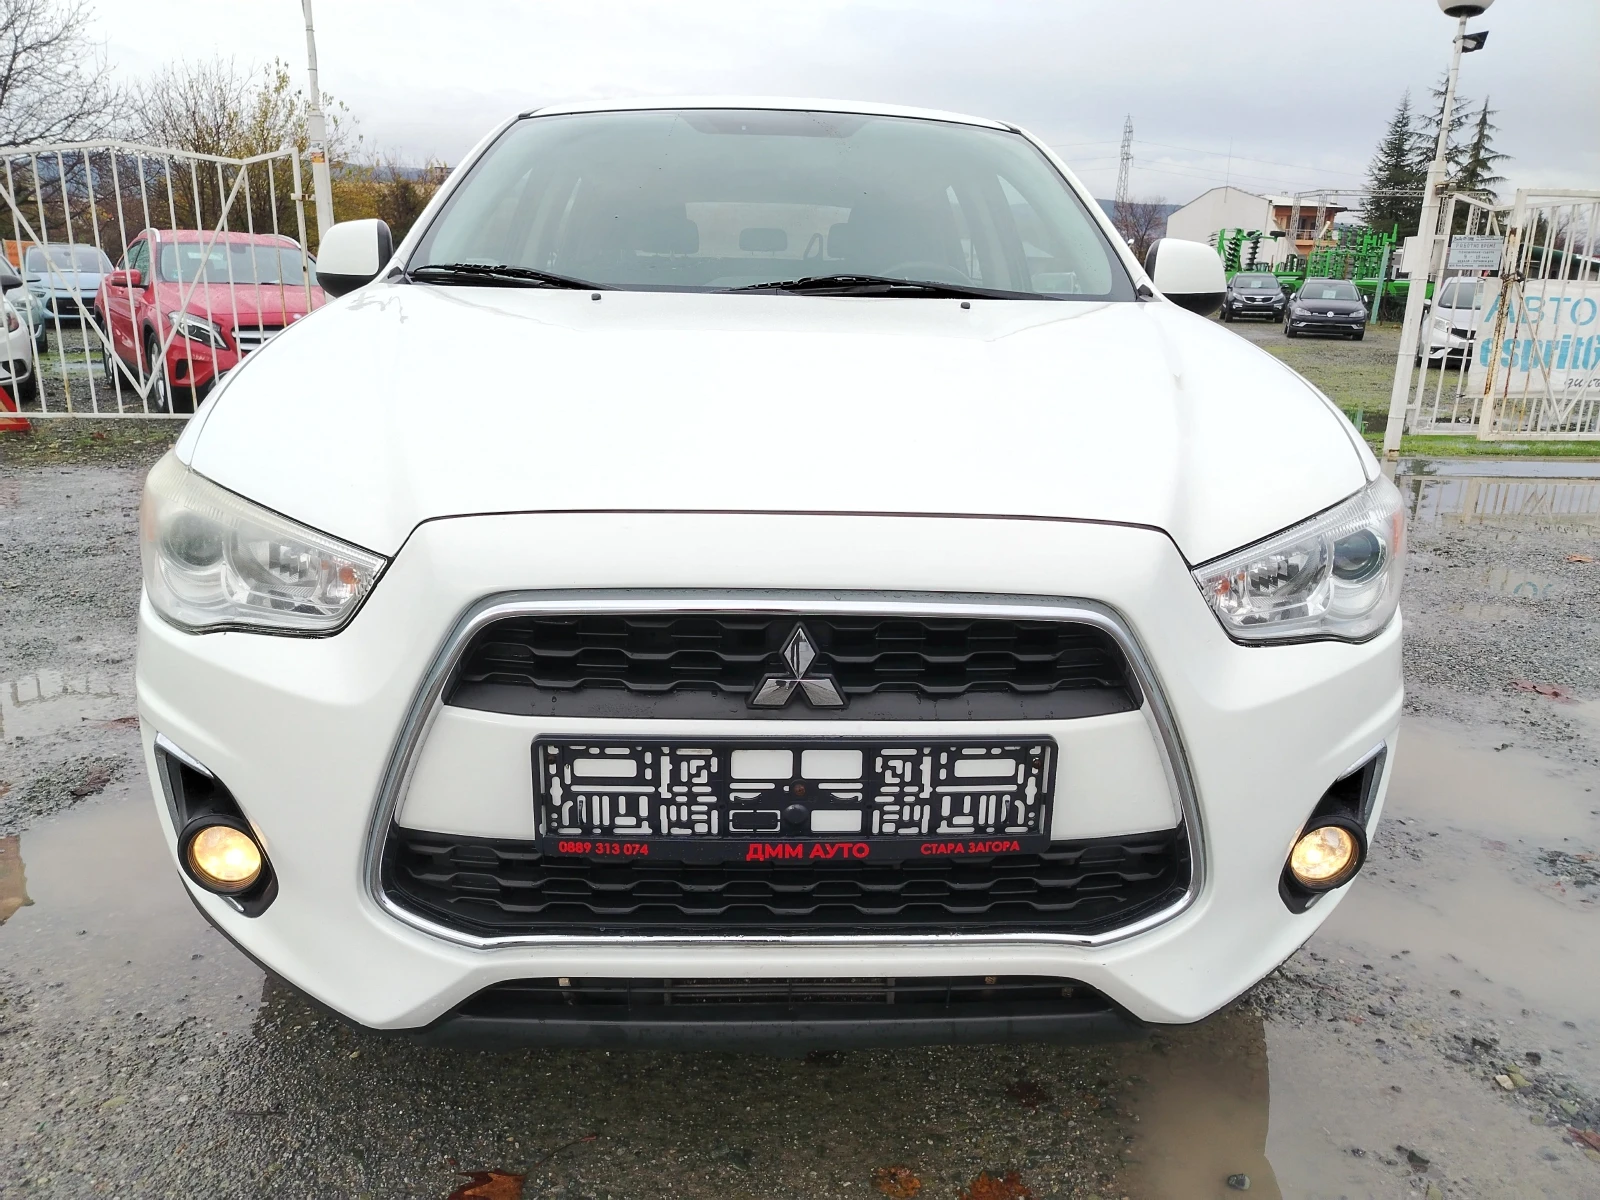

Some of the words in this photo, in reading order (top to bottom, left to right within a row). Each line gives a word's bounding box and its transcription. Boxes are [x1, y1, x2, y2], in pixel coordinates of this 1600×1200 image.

[558, 841, 592, 854] 0889
[595, 842, 621, 855] 313
[623, 843, 649, 856] 074
[745, 843, 804, 862] ДММ
[809, 842, 870, 859] АУТО
[920, 842, 965, 855] СТАРА
[968, 840, 1020, 854] ЗАГОРА
